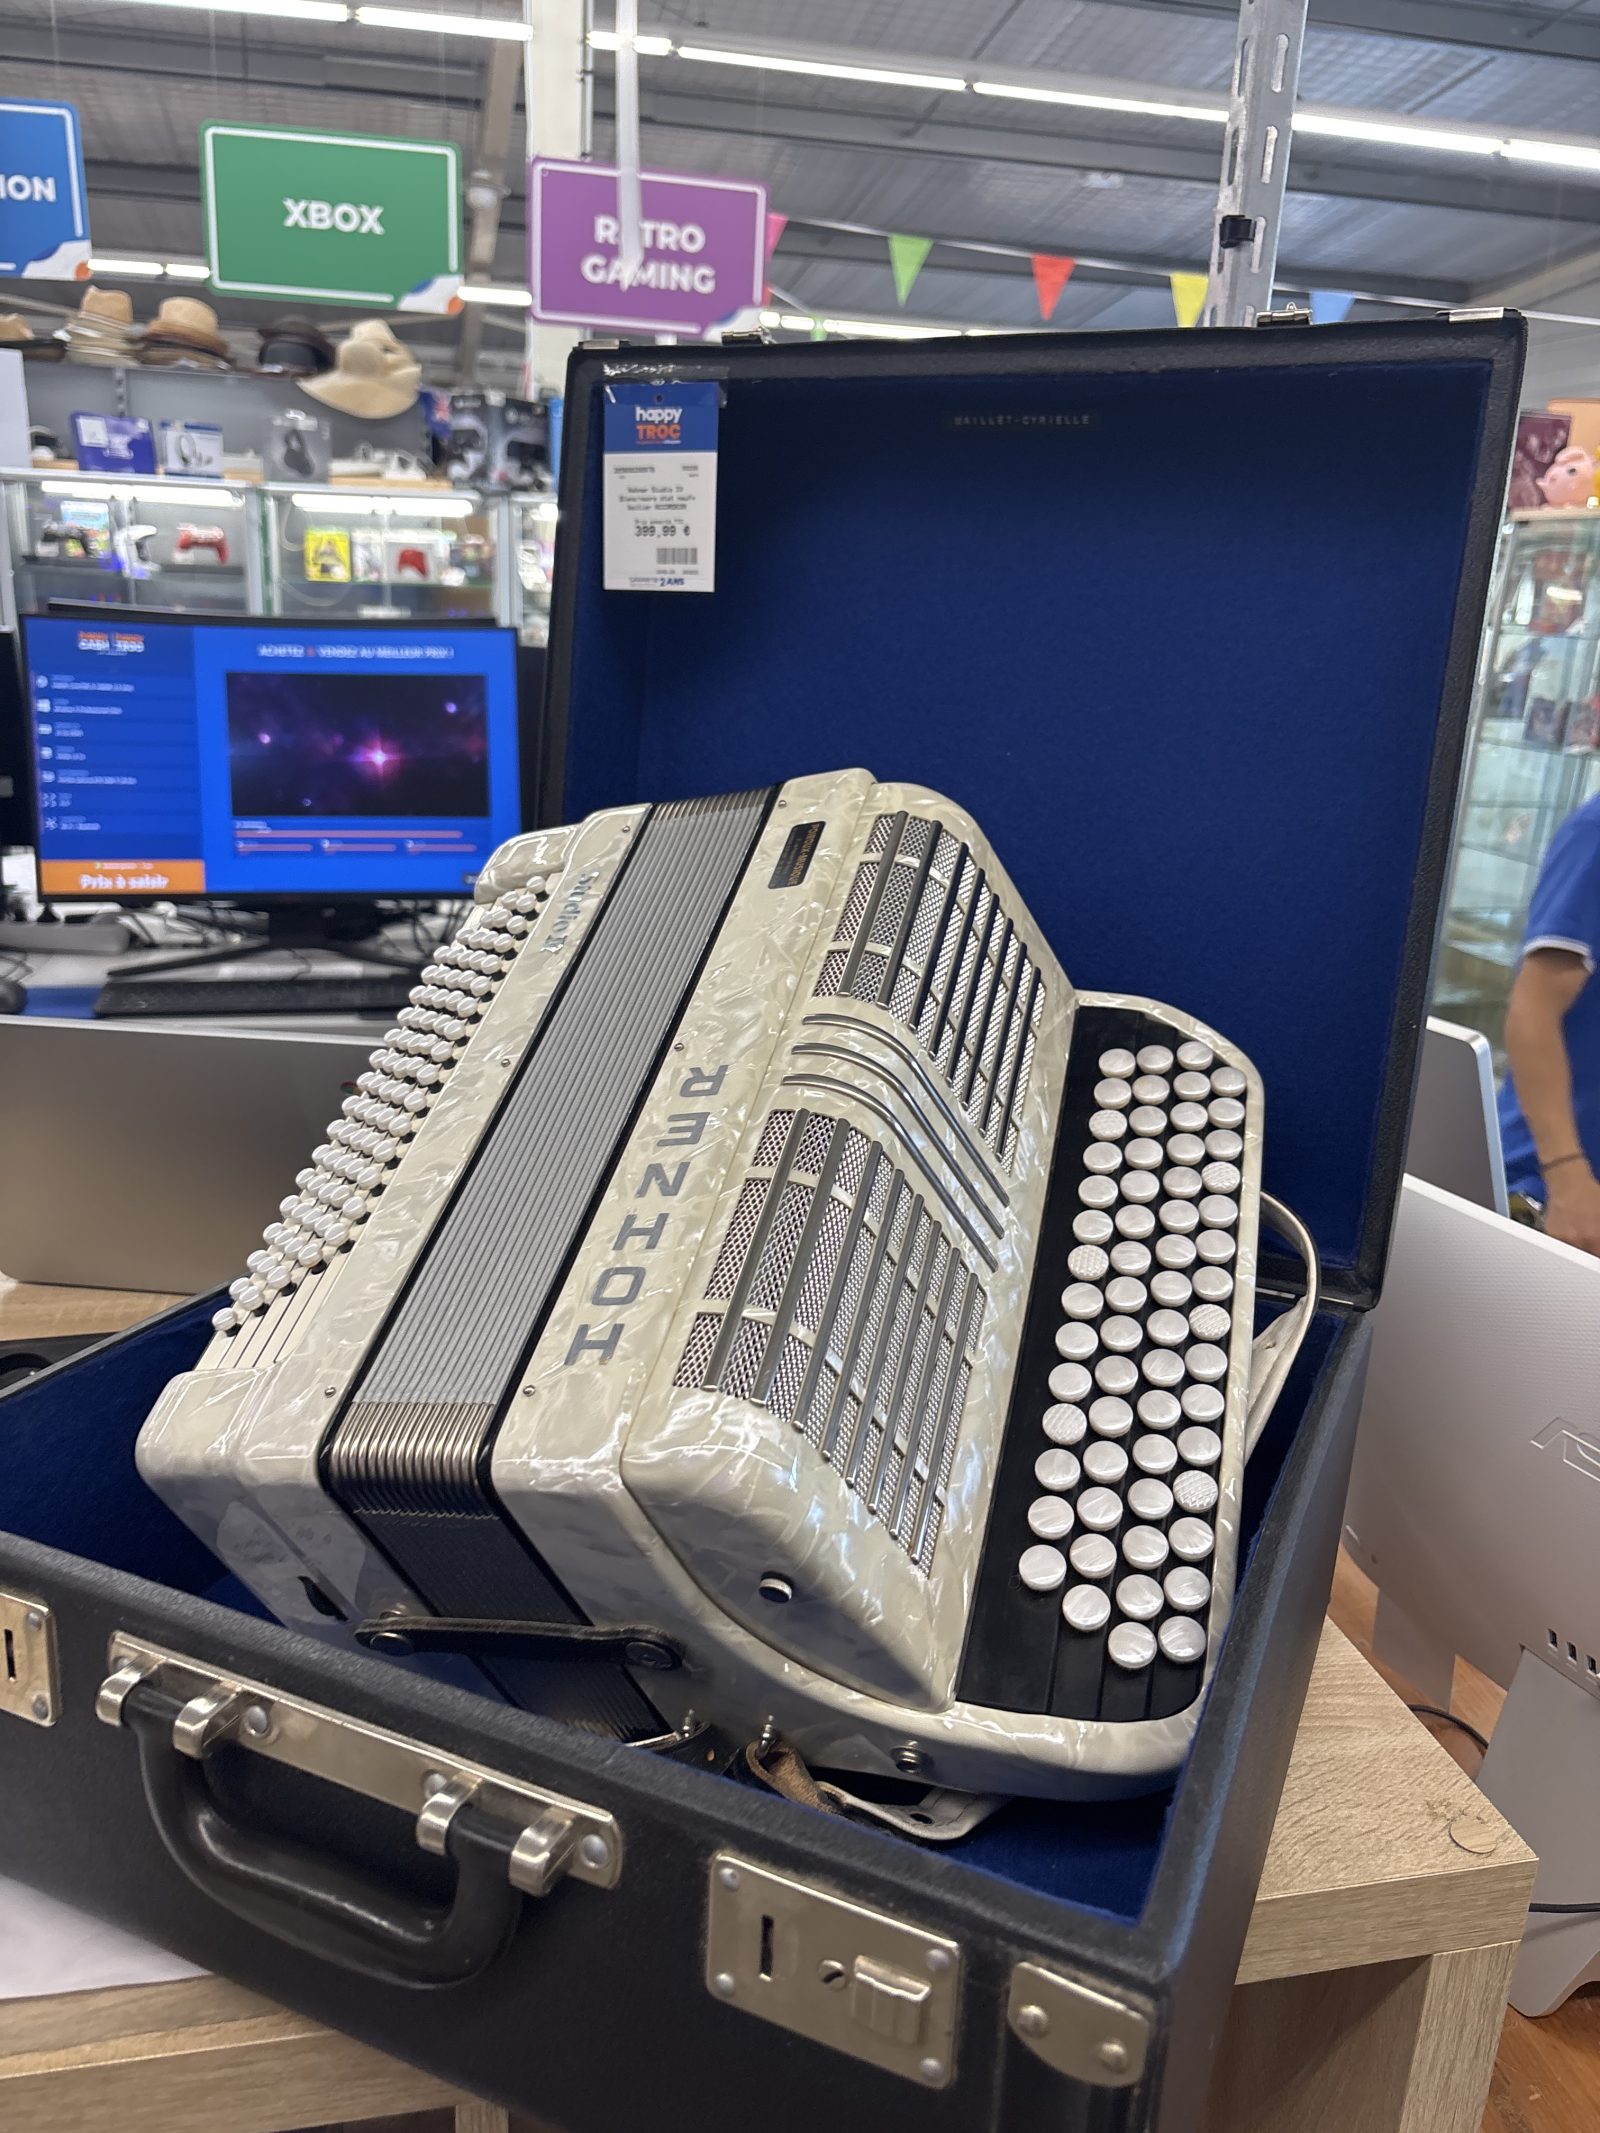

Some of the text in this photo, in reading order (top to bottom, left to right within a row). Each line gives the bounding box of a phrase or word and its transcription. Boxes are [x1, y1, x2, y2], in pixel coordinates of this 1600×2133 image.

[0, 174, 57, 202] ION
[282, 197, 385, 235] XBOX
[594, 215, 706, 253] RTRO
[580, 254, 716, 294] GAMING
[635, 406, 683, 424] happy
[636, 424, 681, 440] TROC
[634, 525, 676, 538] 399,99
[564, 1064, 729, 1366] HOHNER
